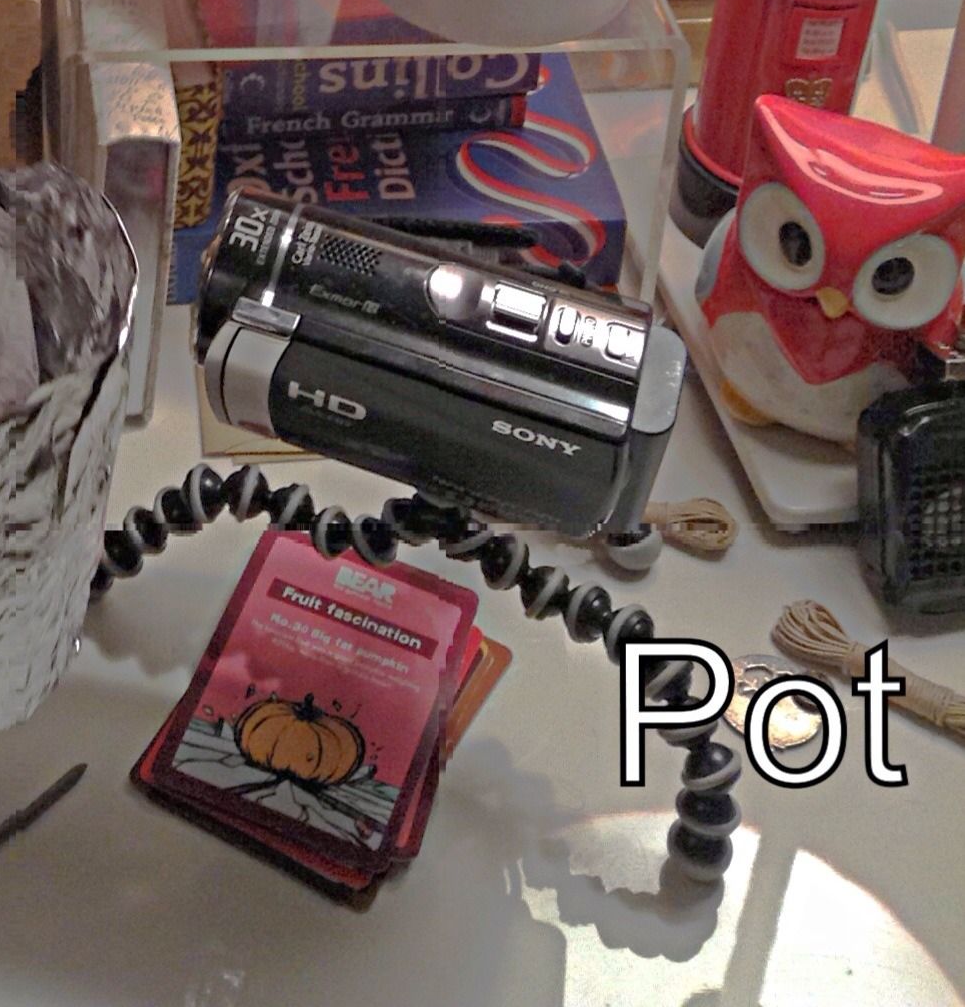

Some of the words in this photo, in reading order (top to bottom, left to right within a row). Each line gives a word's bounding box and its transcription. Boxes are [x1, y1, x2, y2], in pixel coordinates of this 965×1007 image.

[319, 54, 530, 100] Collins
[246, 111, 332, 135] French
[324, 137, 370, 202] Fre
[228, 206, 270, 252] 30x
[287, 380, 368, 421] HD
[492, 420, 582, 457] SONY
[336, 564, 397, 603] BEAR
[281, 585, 323, 612] Fruit
[327, 600, 423, 651] fascination
[310, 626, 331, 645] Big
[334, 635, 354, 654] fat
[356, 647, 410, 674] pumpkin
